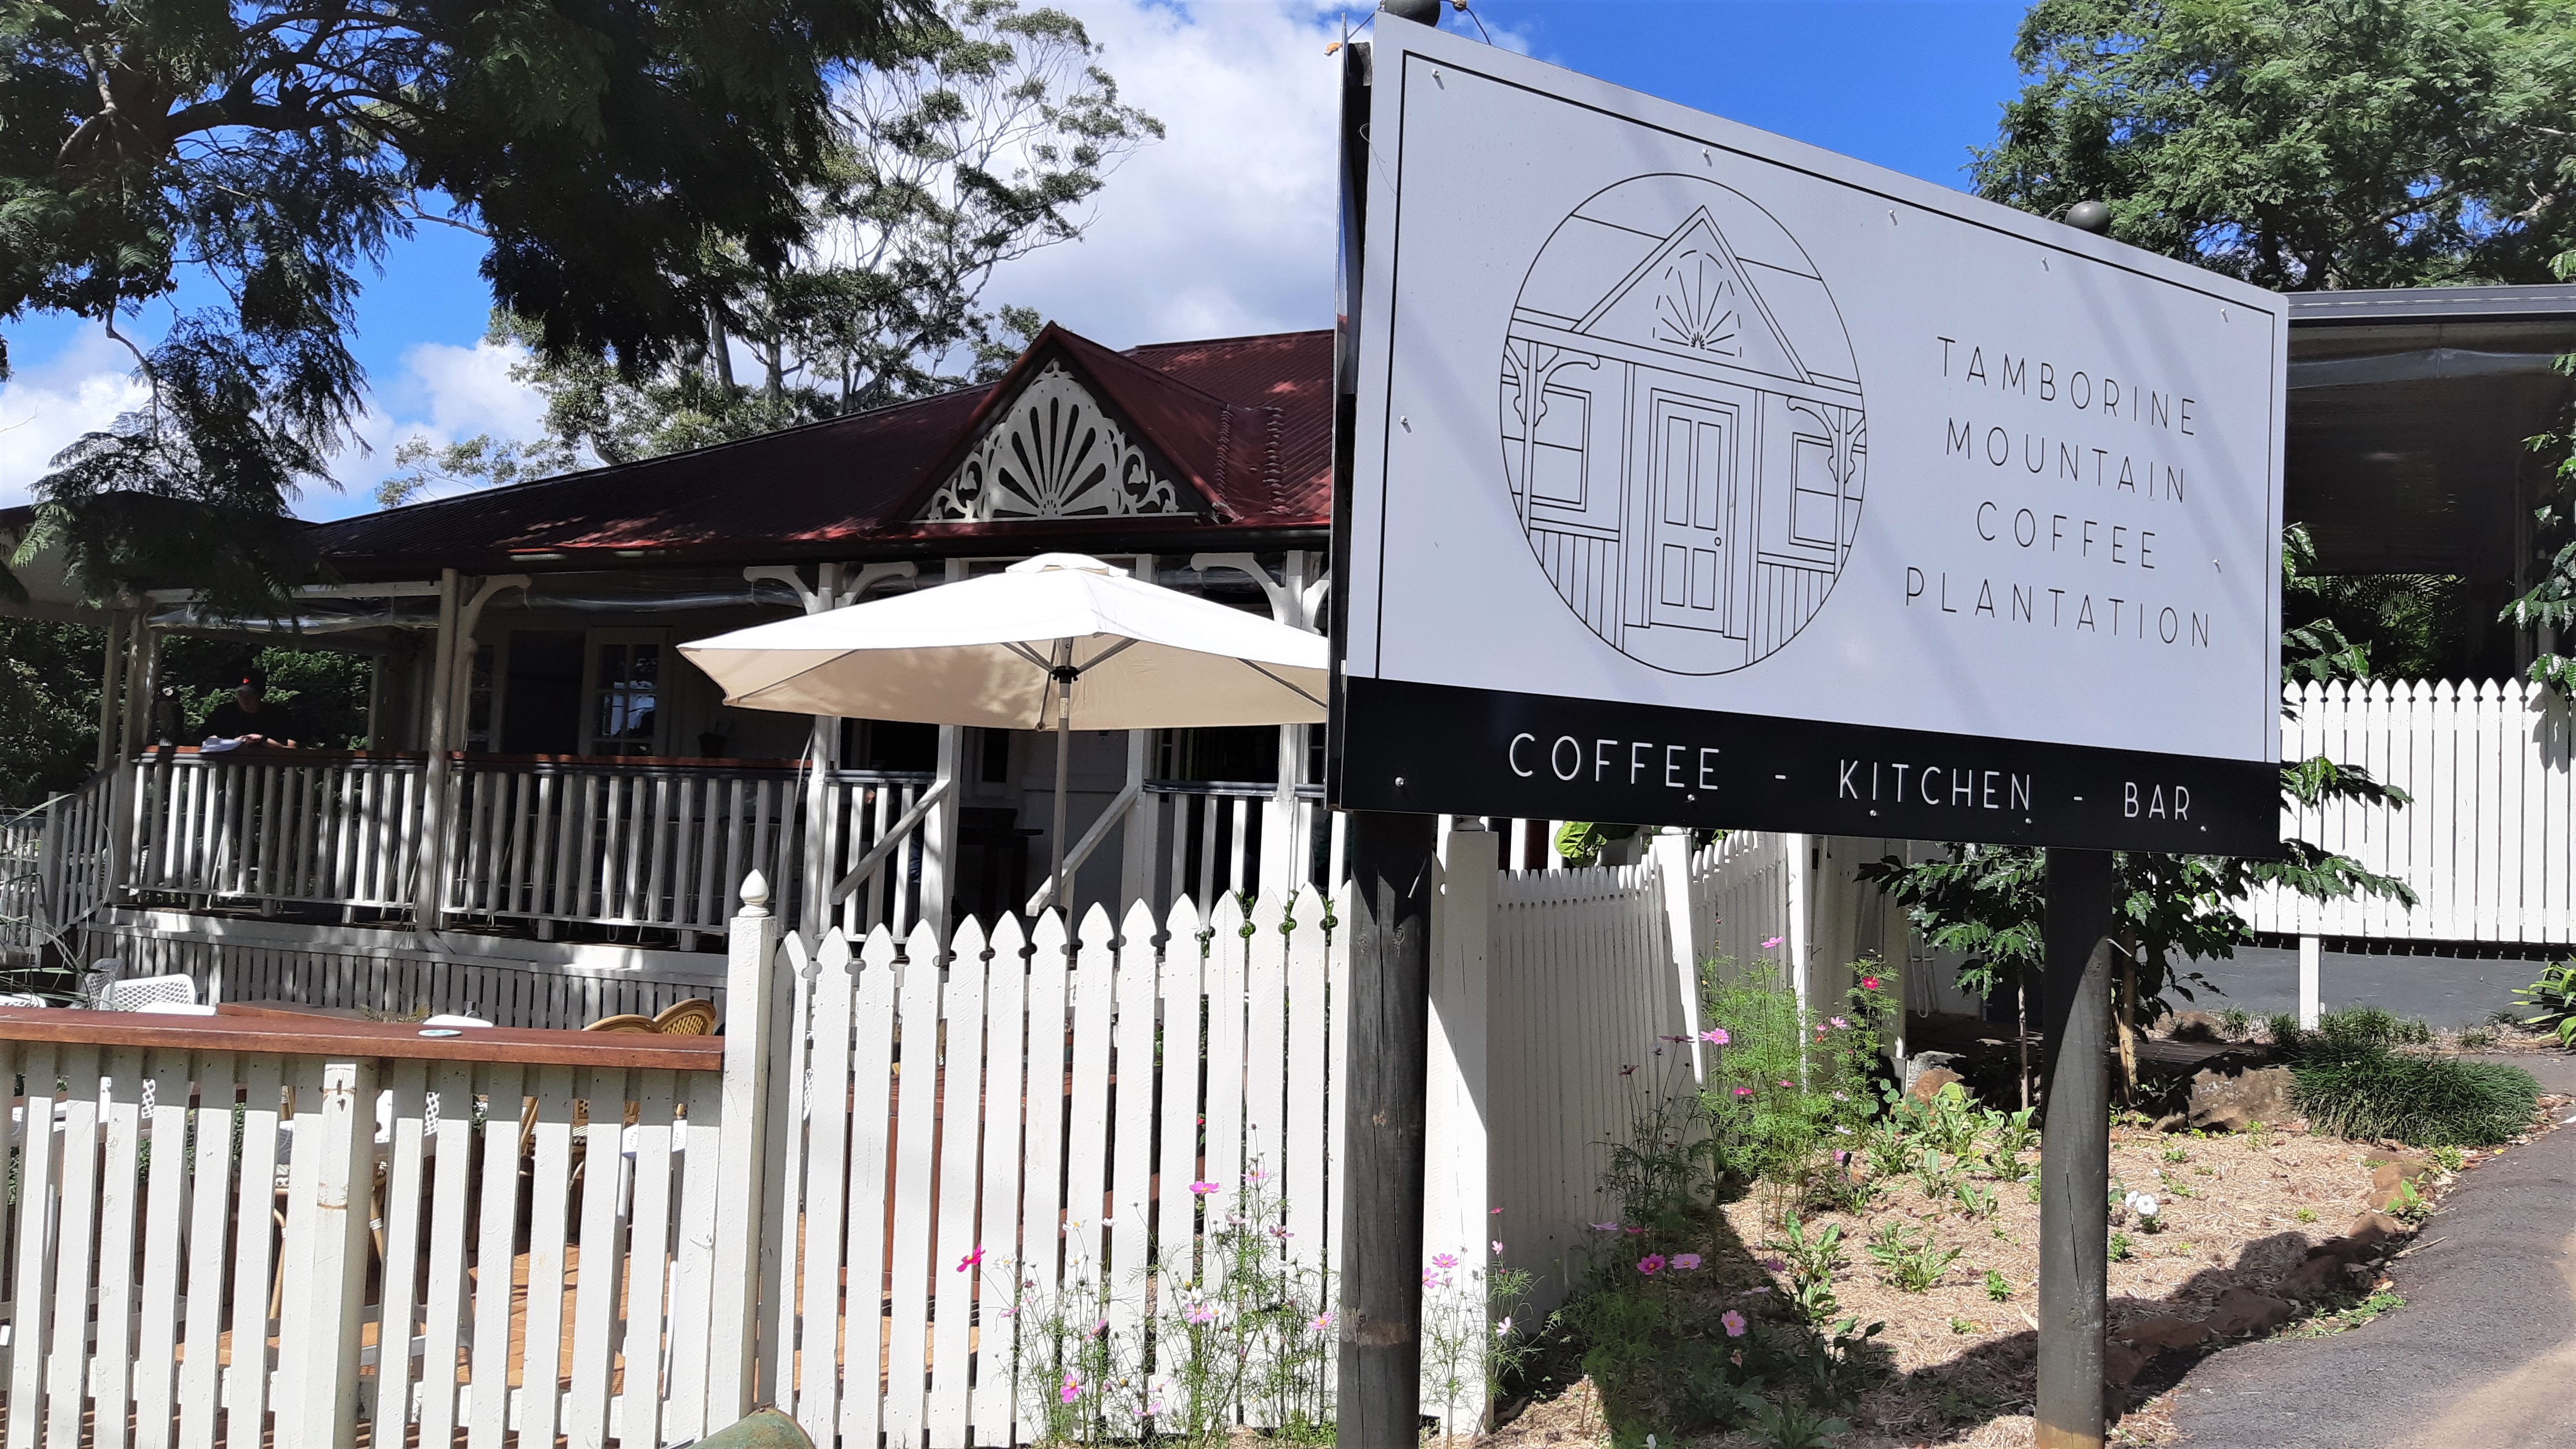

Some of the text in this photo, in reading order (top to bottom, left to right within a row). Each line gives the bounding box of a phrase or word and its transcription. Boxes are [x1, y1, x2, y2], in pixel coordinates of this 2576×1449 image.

[1937, 336, 2195, 435] TAMBORINE
[1947, 417, 2184, 503] MOUNTAIN
[1977, 501, 2156, 569] COFFEE
[1906, 566, 2208, 648] PLANTATION
[1509, 733, 1720, 790] COFFEE
[1839, 759, 2030, 811] KITCHEN
[2124, 782, 2190, 821] BAR
